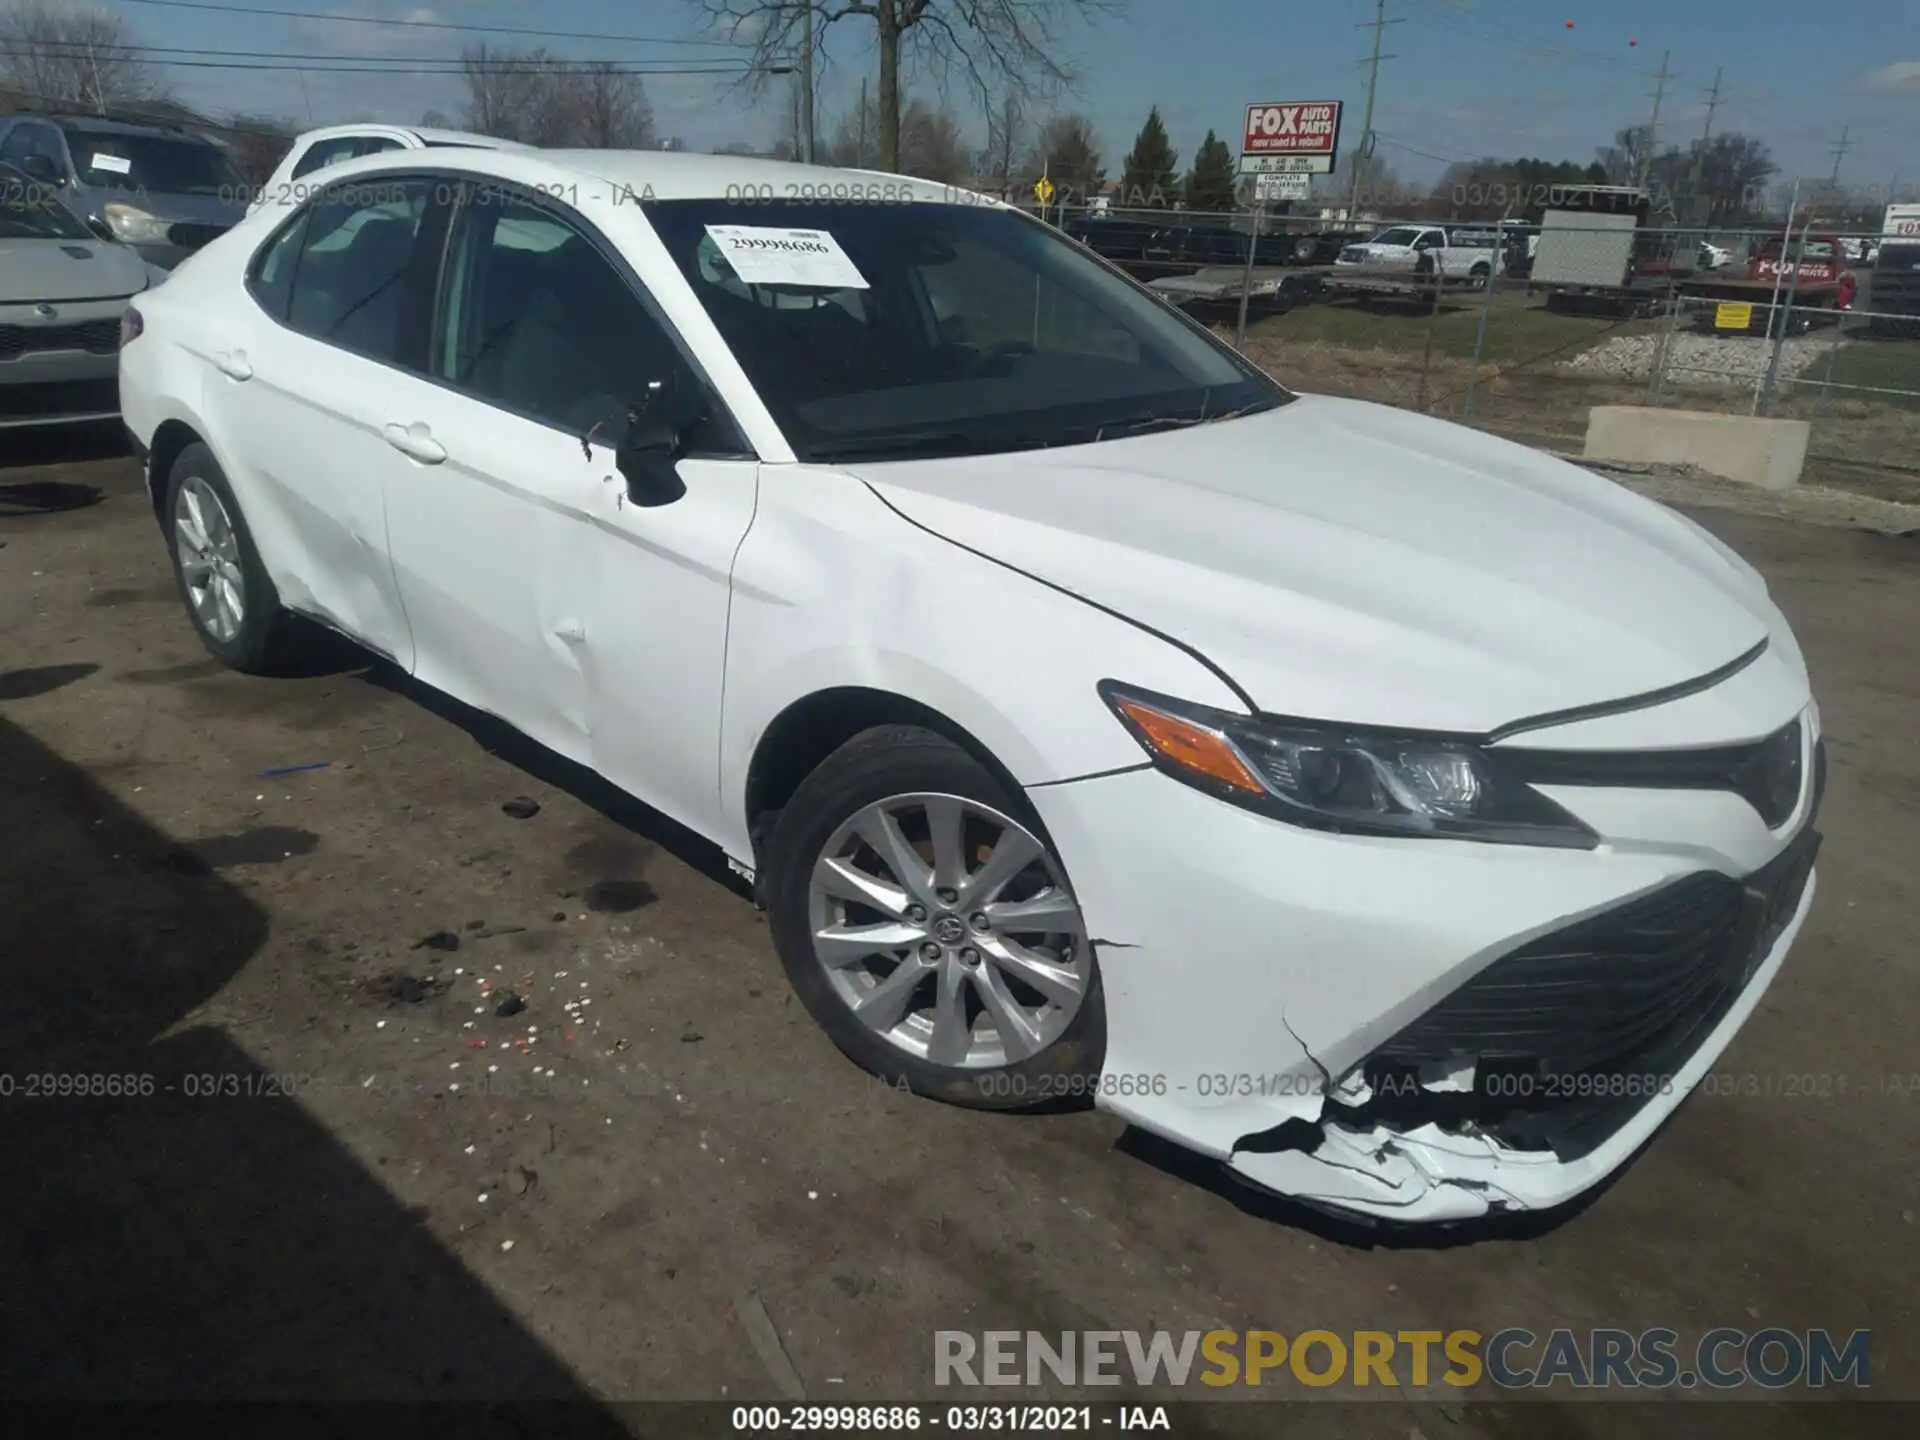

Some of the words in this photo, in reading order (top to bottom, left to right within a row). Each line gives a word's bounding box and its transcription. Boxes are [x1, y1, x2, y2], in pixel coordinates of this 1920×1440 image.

[1248, 107, 1300, 135] FOX
[1300, 106, 1330, 121] AUTO
[1298, 120, 1332, 134] PARTS
[728, 237, 830, 254] 29998686
